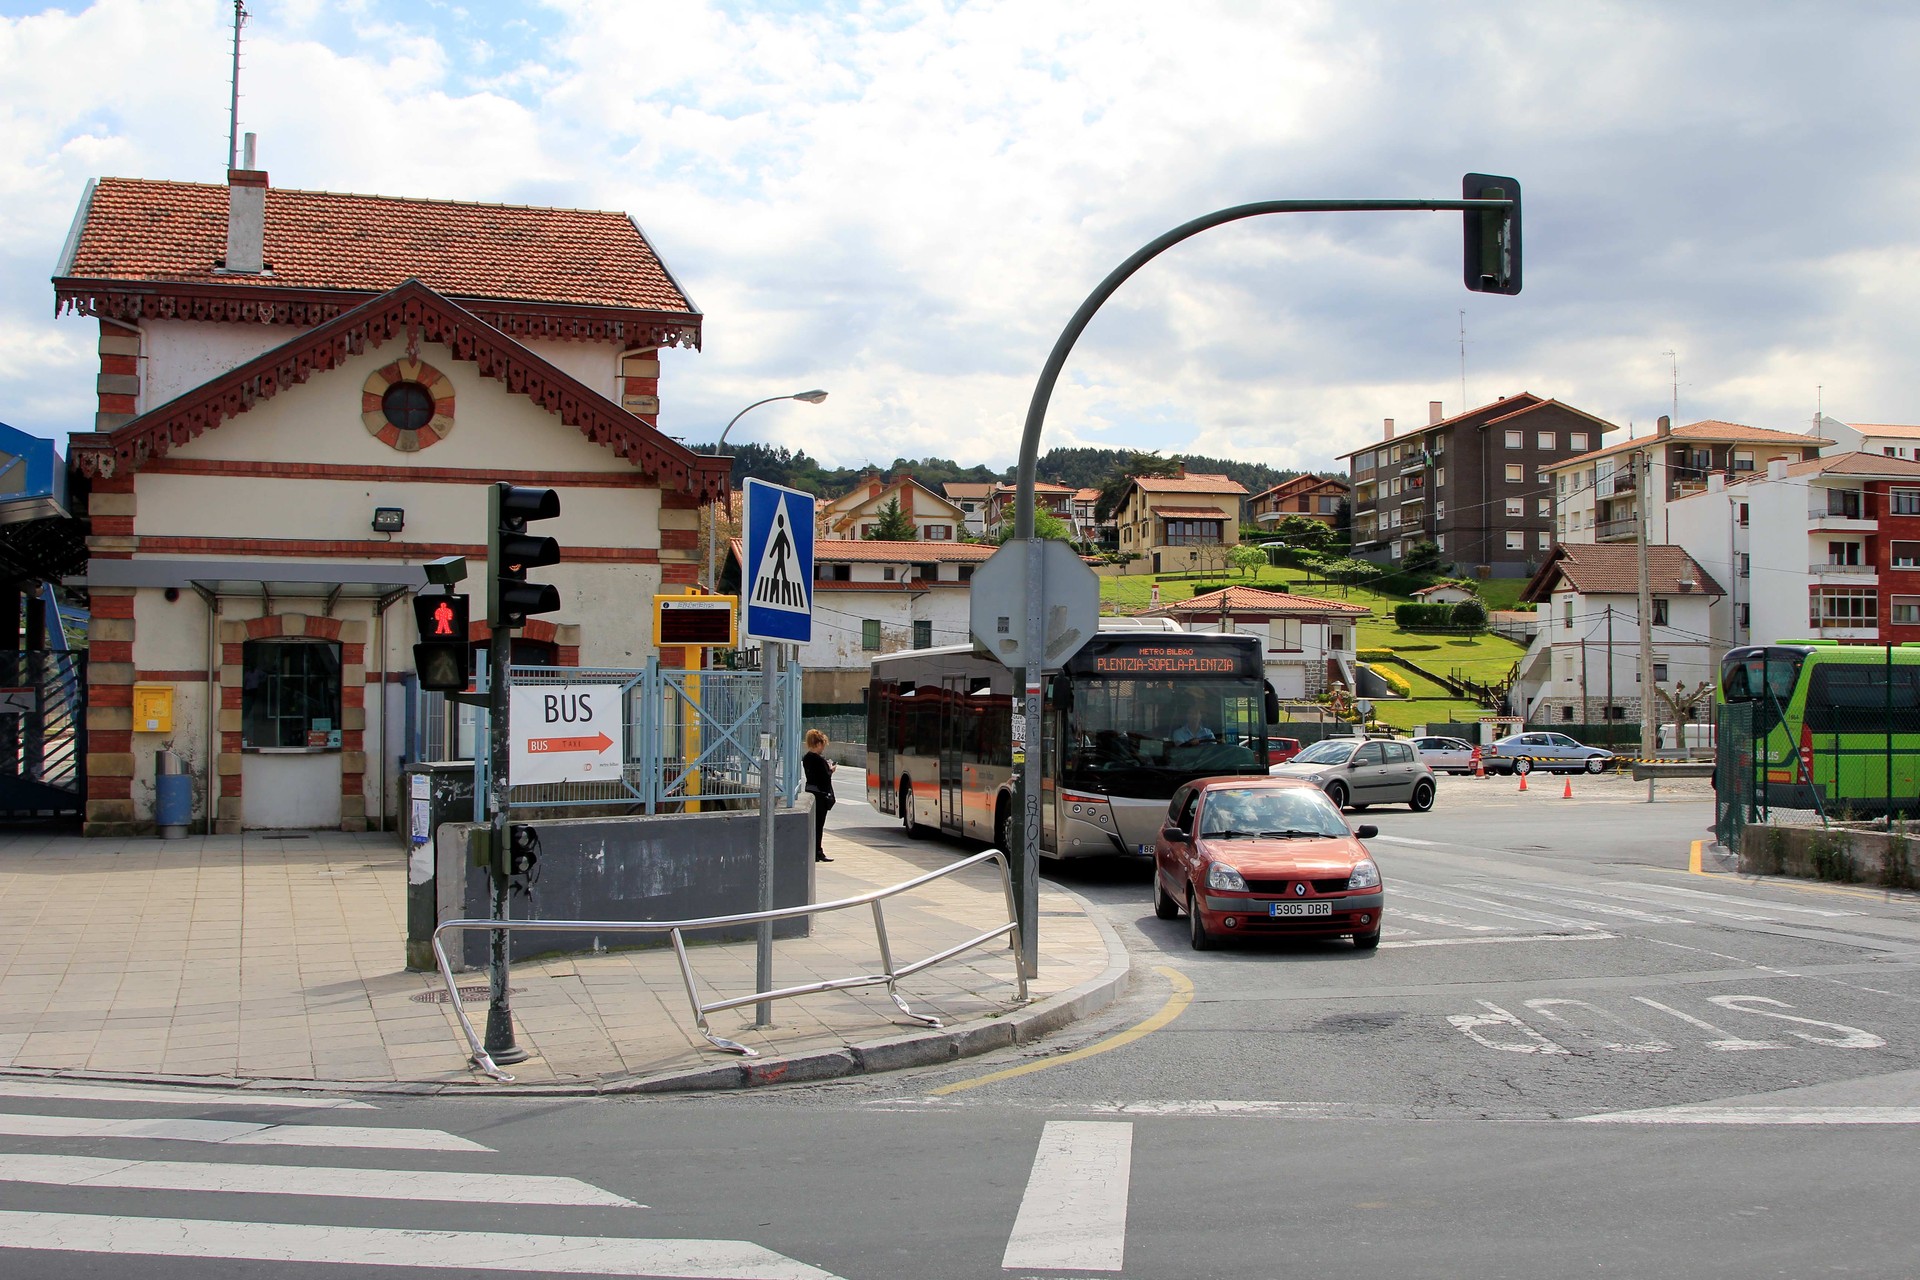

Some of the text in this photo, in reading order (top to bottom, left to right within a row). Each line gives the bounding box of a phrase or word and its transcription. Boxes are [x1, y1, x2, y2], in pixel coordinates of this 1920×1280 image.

[1139, 648, 1194, 656] METRO BILBAO
[1097, 657, 1234, 672] PLENTZIA-SOPELA-PLENTZIA
[544, 693, 593, 723] BUS
[531, 740, 582, 751] BUS TAXI
[1275, 903, 1330, 915] 5905 DBR
[1445, 994, 1887, 1056] STOP
